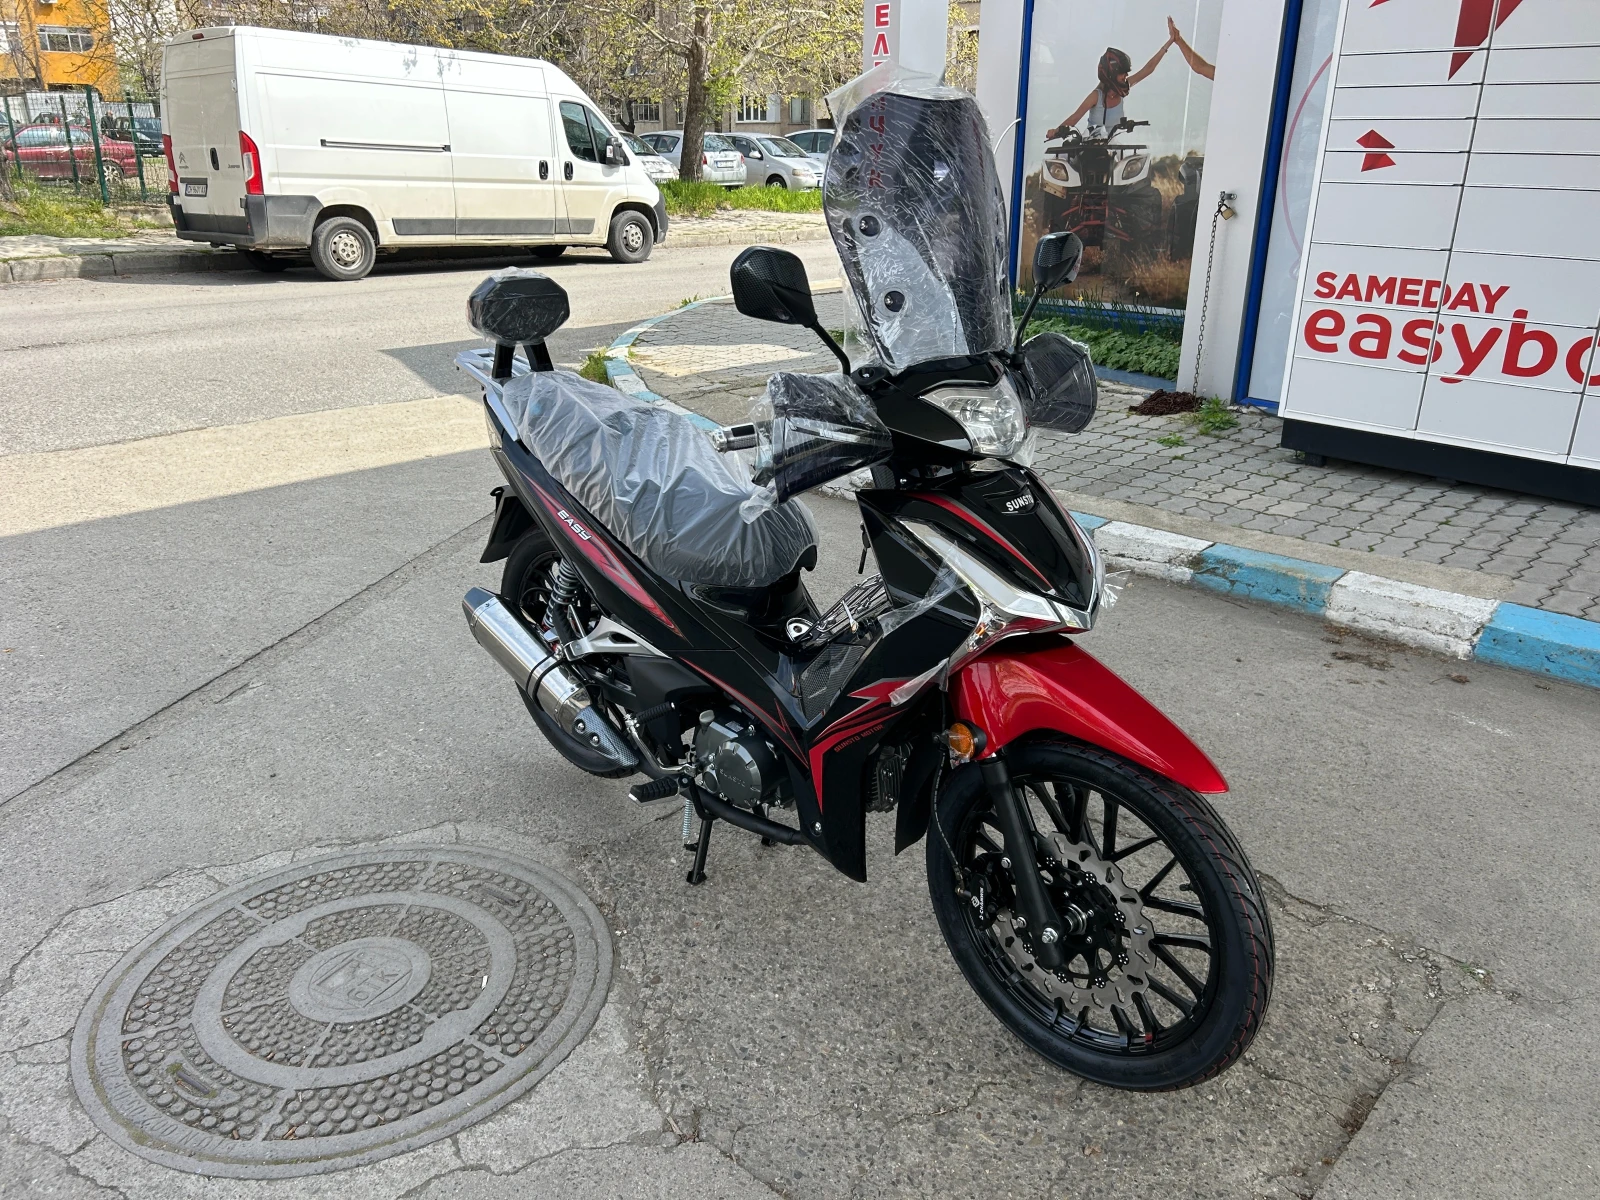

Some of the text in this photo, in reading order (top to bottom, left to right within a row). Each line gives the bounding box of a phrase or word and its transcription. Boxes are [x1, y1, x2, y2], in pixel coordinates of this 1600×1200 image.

[1313, 271, 1510, 314] SAMEDAY
[1303, 308, 1600, 387] easybo
[557, 509, 592, 541] EASY
[833, 724, 885, 753] SUNSTO MOTOR
